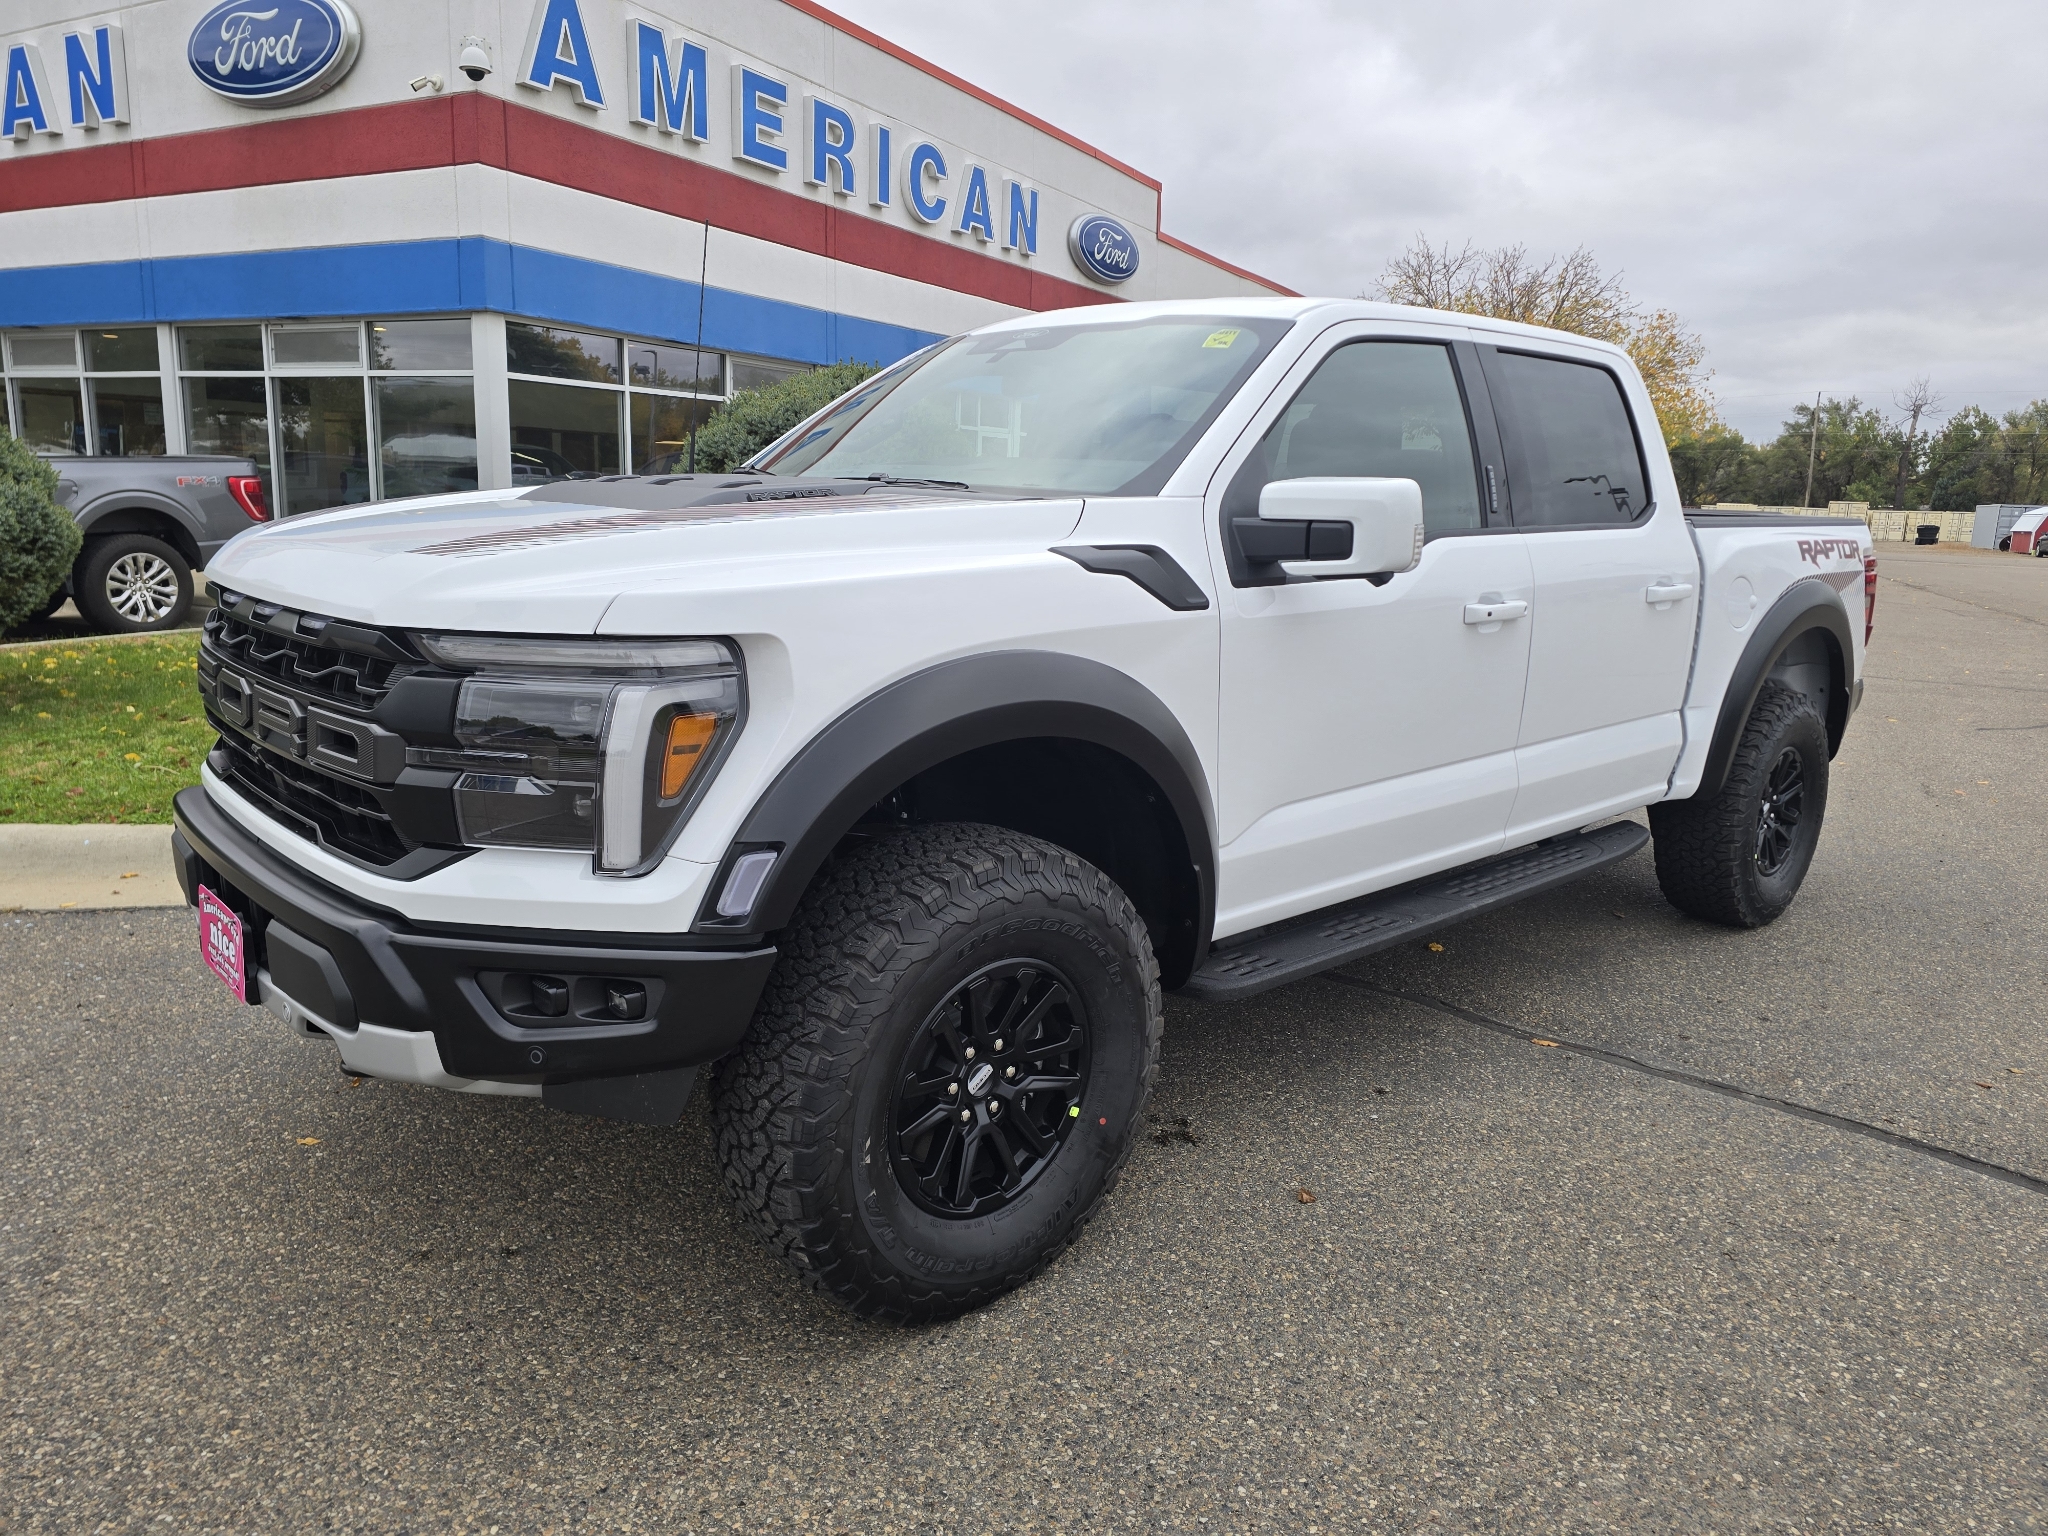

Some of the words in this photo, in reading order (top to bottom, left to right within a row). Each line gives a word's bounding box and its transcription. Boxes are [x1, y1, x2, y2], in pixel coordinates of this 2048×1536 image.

[214, 8, 302, 76] Ford
[1, 23, 128, 140] AN
[516, 0, 1038, 257] AMERICAN
[1094, 228, 1130, 269] Ford
[176, 475, 221, 487] FX4
[747, 488, 838, 502] RAPTOR
[1797, 539, 1863, 569] RAPTOR
[210, 920, 235, 964] nice
[956, 918, 1123, 984] BFGoodrich
